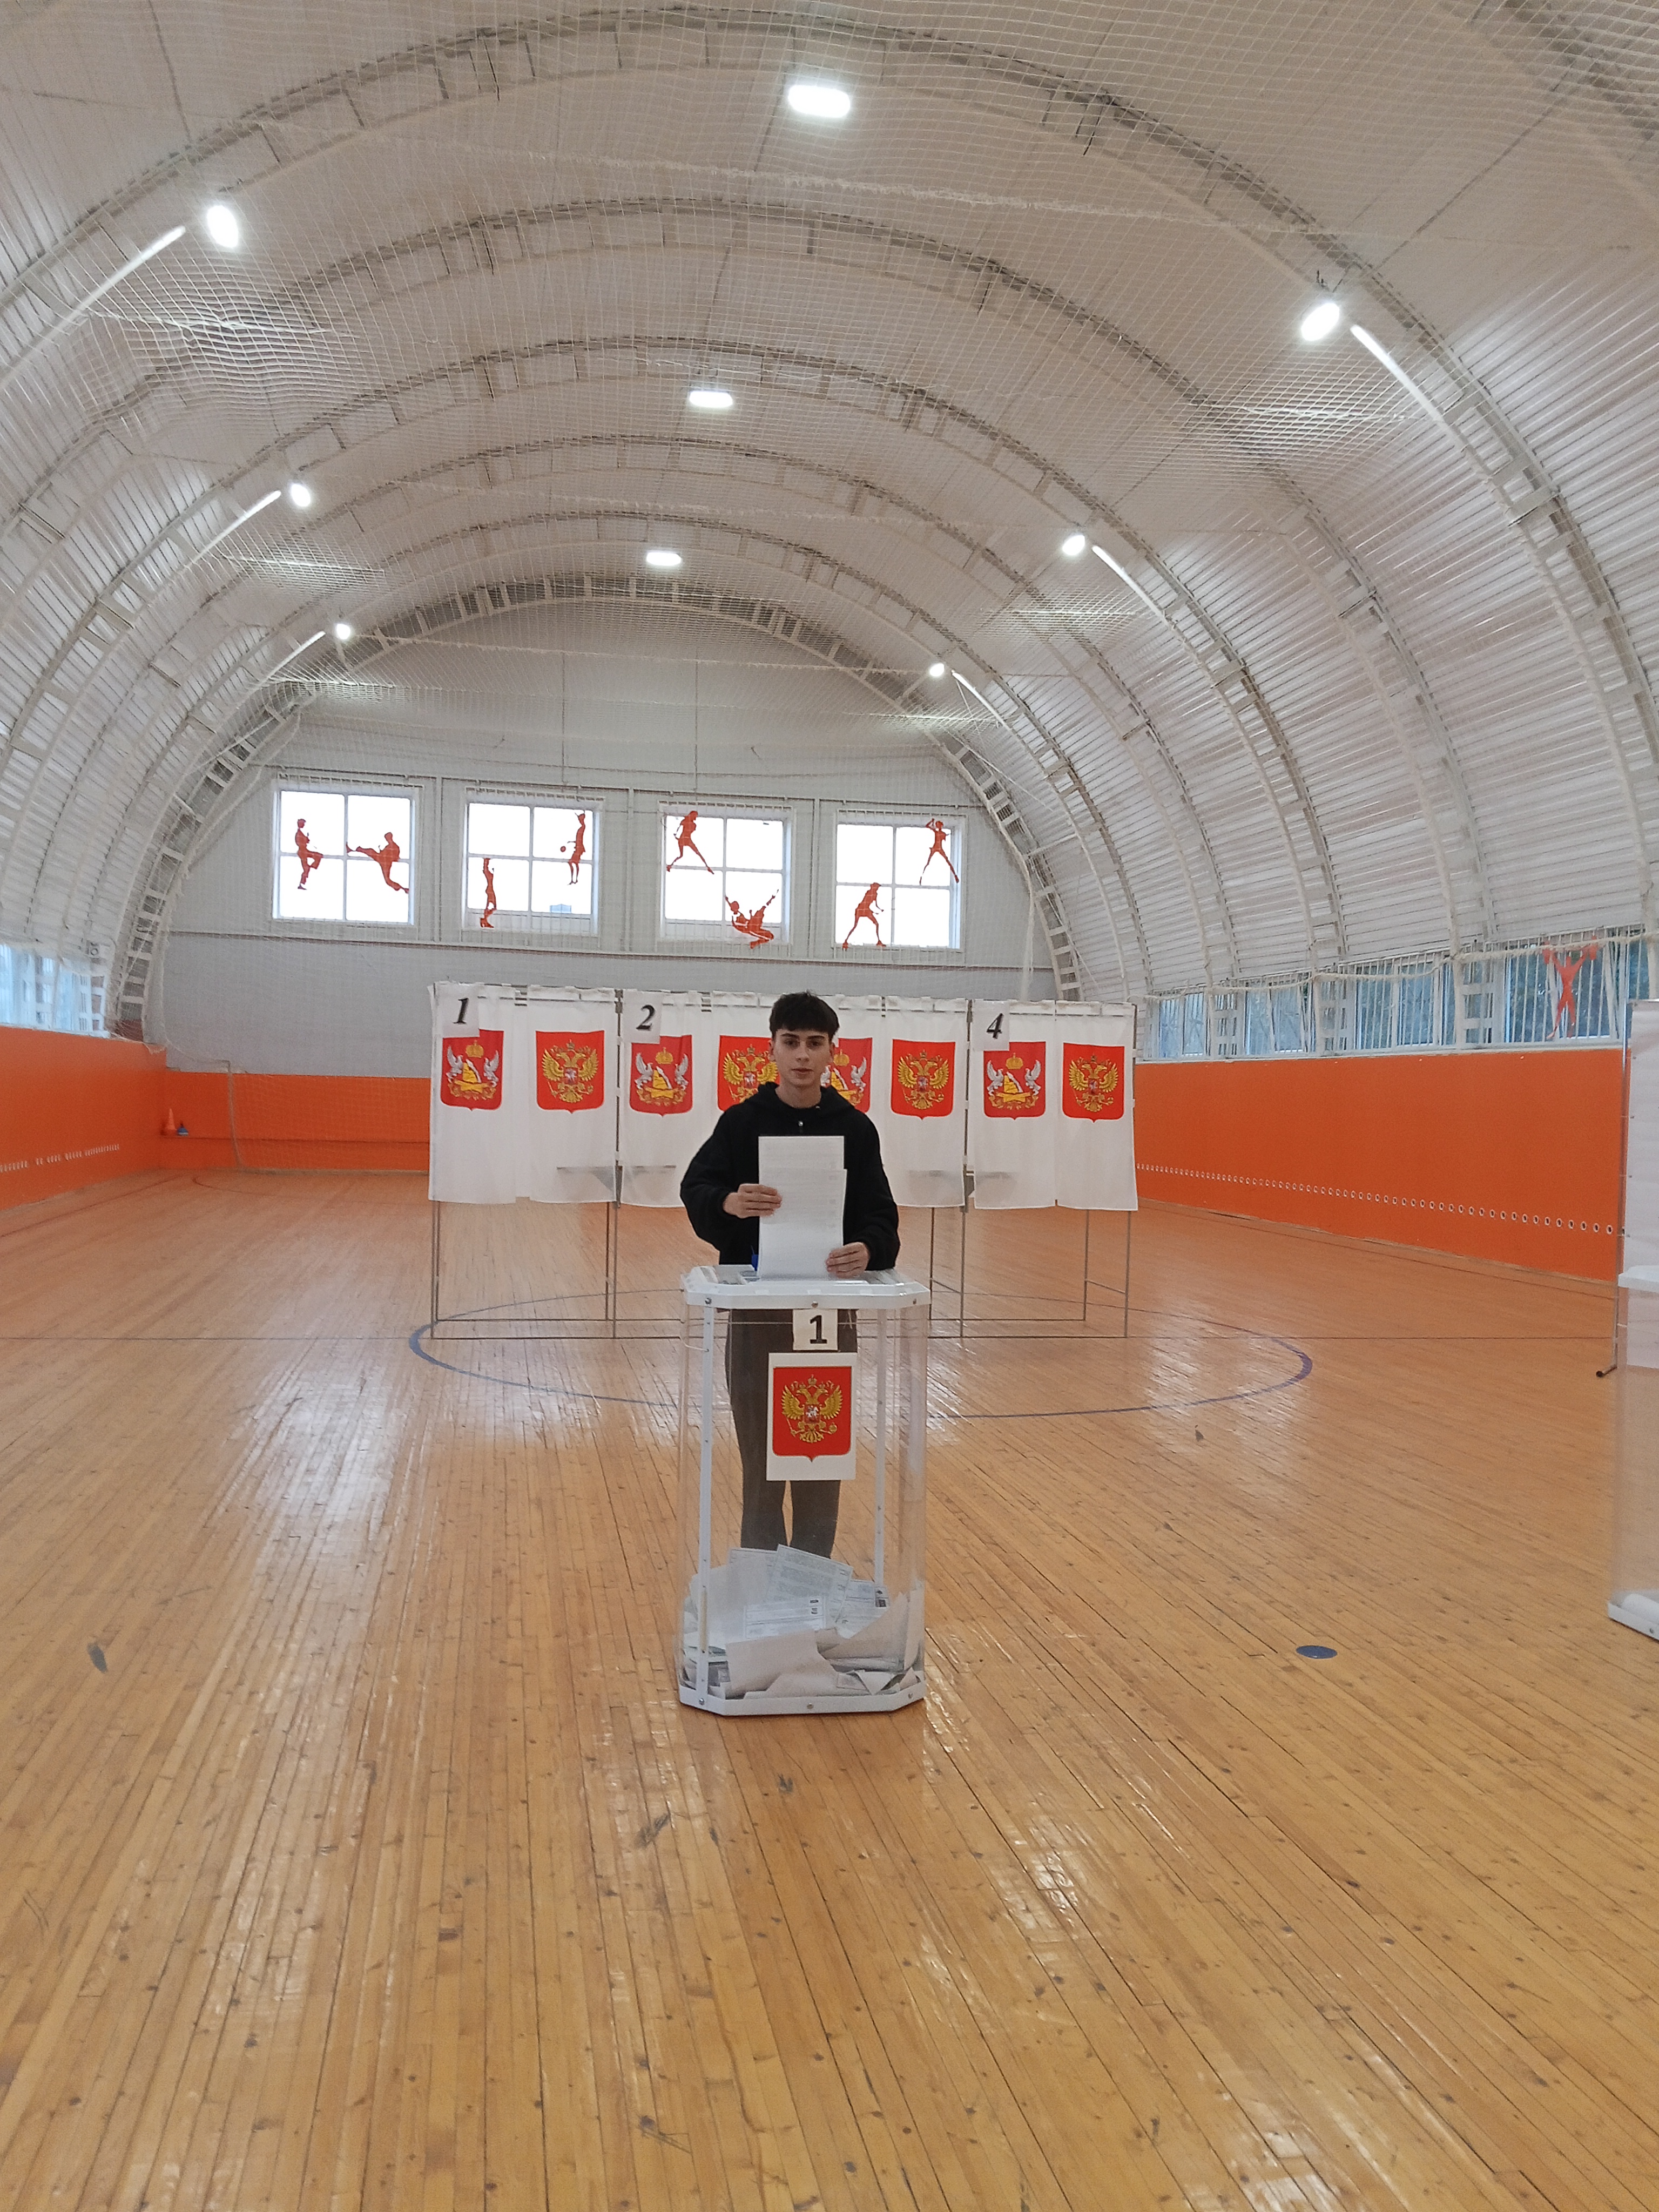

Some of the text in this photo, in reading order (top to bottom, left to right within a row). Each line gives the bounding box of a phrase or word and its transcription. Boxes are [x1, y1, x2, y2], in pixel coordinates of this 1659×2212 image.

[453, 997, 469, 1024] 1
[636, 1004, 655, 1031] 2
[986, 1013, 1003, 1039] 4
[810, 1314, 827, 1344] 1
